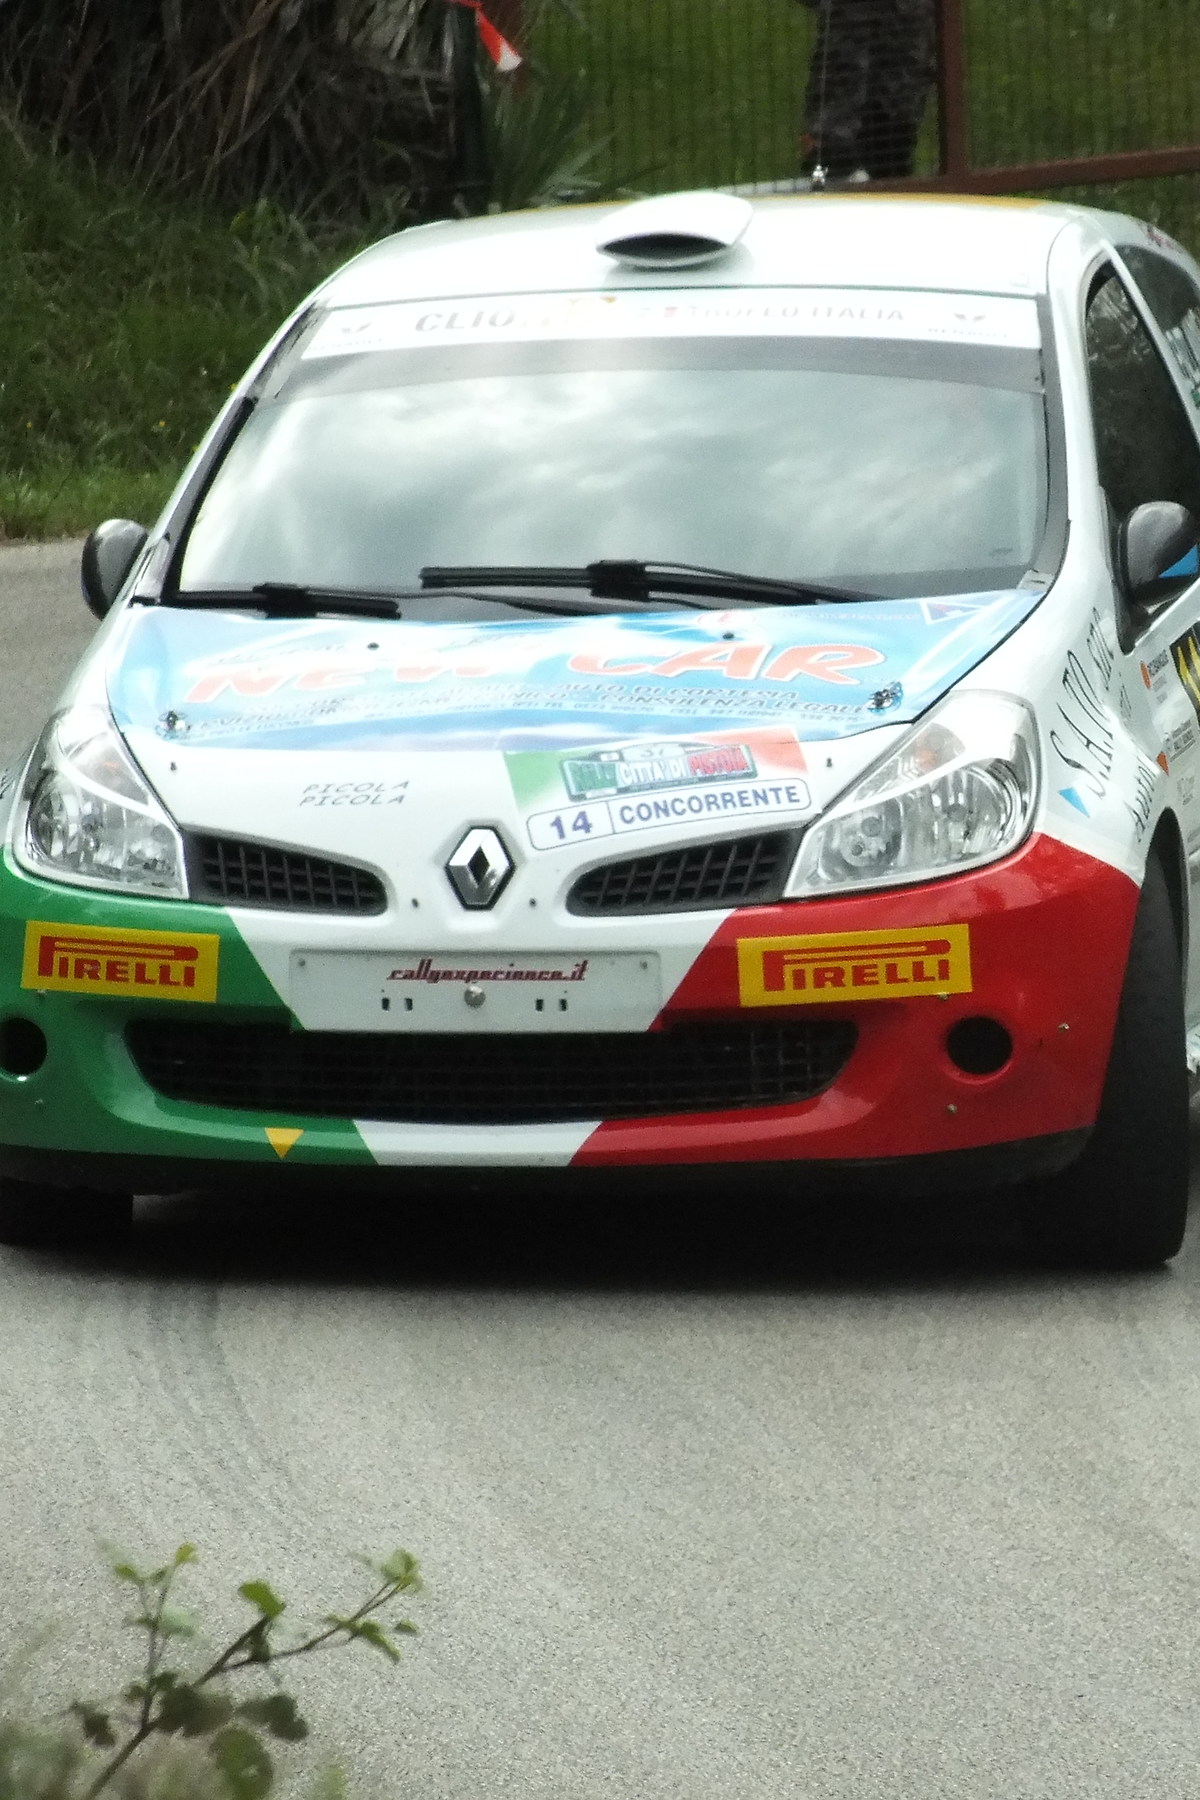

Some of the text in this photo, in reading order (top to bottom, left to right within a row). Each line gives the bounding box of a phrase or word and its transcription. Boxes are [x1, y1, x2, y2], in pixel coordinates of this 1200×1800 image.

[414, 309, 516, 332] CLIO
[812, 306, 905, 320] ITALIA
[184, 645, 530, 703] NEW
[567, 643, 884, 685] CAR
[303, 780, 409, 794] PICOLA
[669, 759, 684, 778] DI
[299, 794, 406, 807] PICOLA
[550, 786, 800, 840] 14 CONCORRENTE
[37, 936, 199, 987] PIRELLI
[761, 939, 952, 991] PIRELLI
